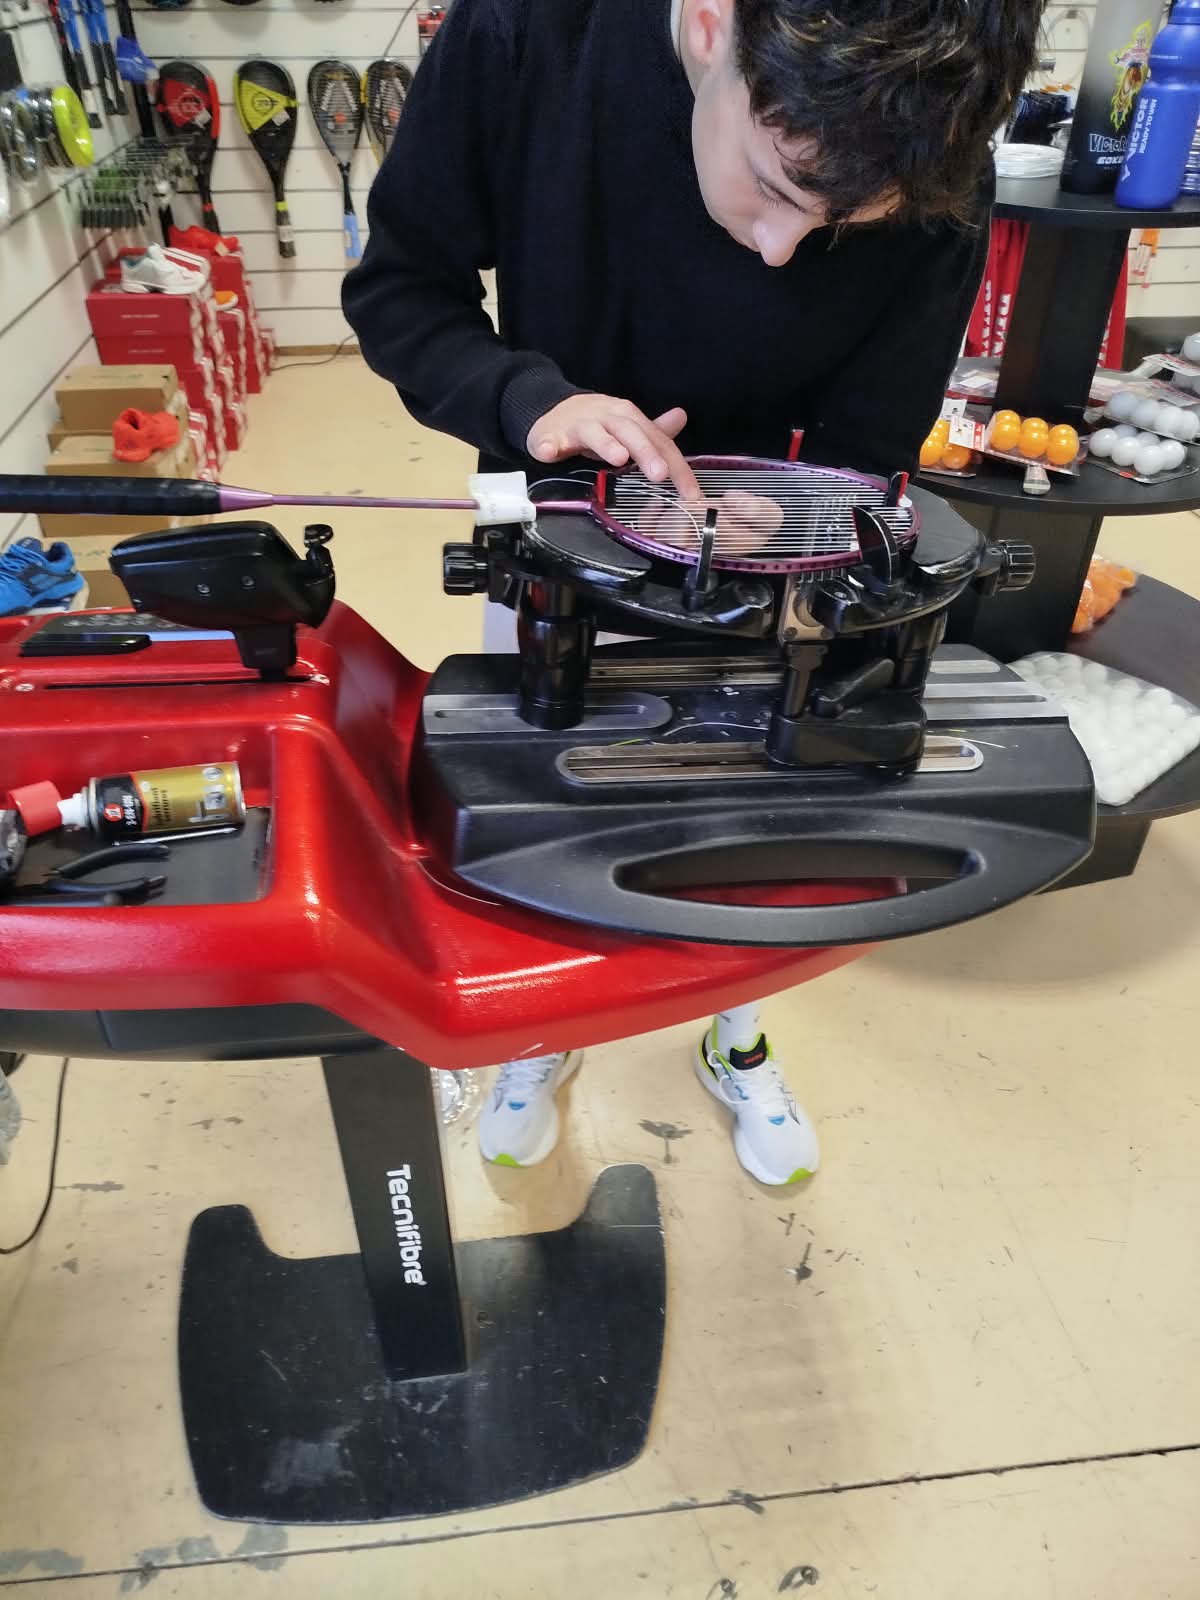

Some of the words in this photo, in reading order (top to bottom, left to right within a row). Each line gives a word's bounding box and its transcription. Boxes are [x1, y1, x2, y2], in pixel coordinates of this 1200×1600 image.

[1126, 98, 1149, 160] VICTOR
[1139, 127, 1150, 154] READY
[1145, 115, 1154, 127] TO
[386, 1163, 428, 1286] Tecnifibre
